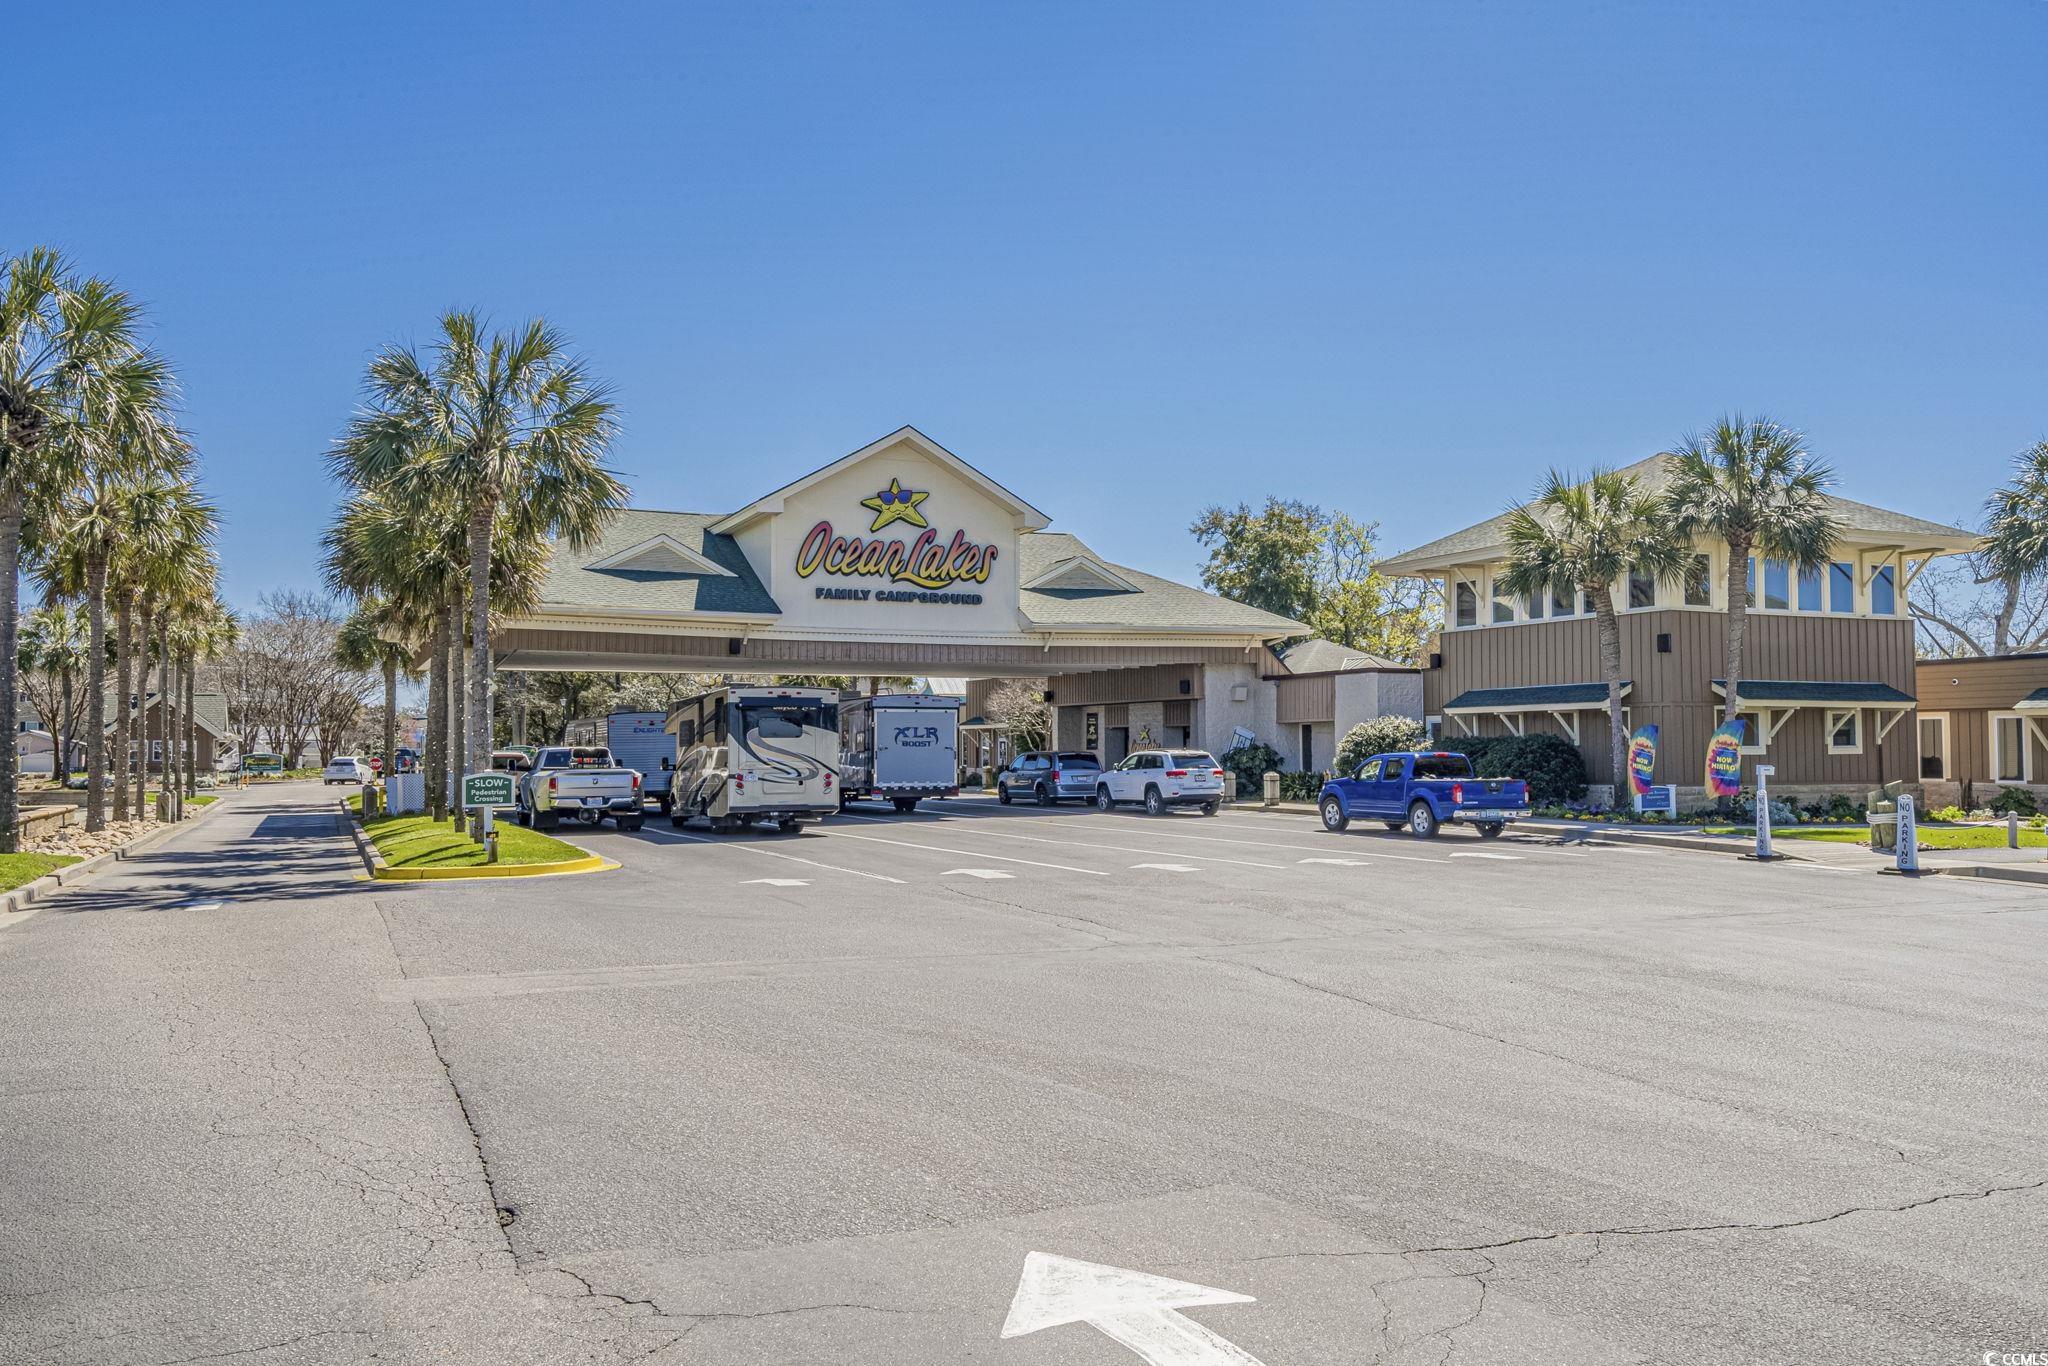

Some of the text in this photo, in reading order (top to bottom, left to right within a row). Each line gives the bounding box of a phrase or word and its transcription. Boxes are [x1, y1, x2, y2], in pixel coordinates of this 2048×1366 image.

[796, 521, 999, 590] Ocean Lakes
[815, 587, 983, 606] FAMILY CAMPGROUND
[894, 726, 939, 745] XLR
[902, 740, 931, 748] BOOST
[1636, 757, 1648, 765] NOW
[1716, 756, 1732, 764] NOW
[1632, 763, 1652, 772] HIRING
[1711, 763, 1736, 772] HIRING
[1899, 803, 1910, 812] NO
